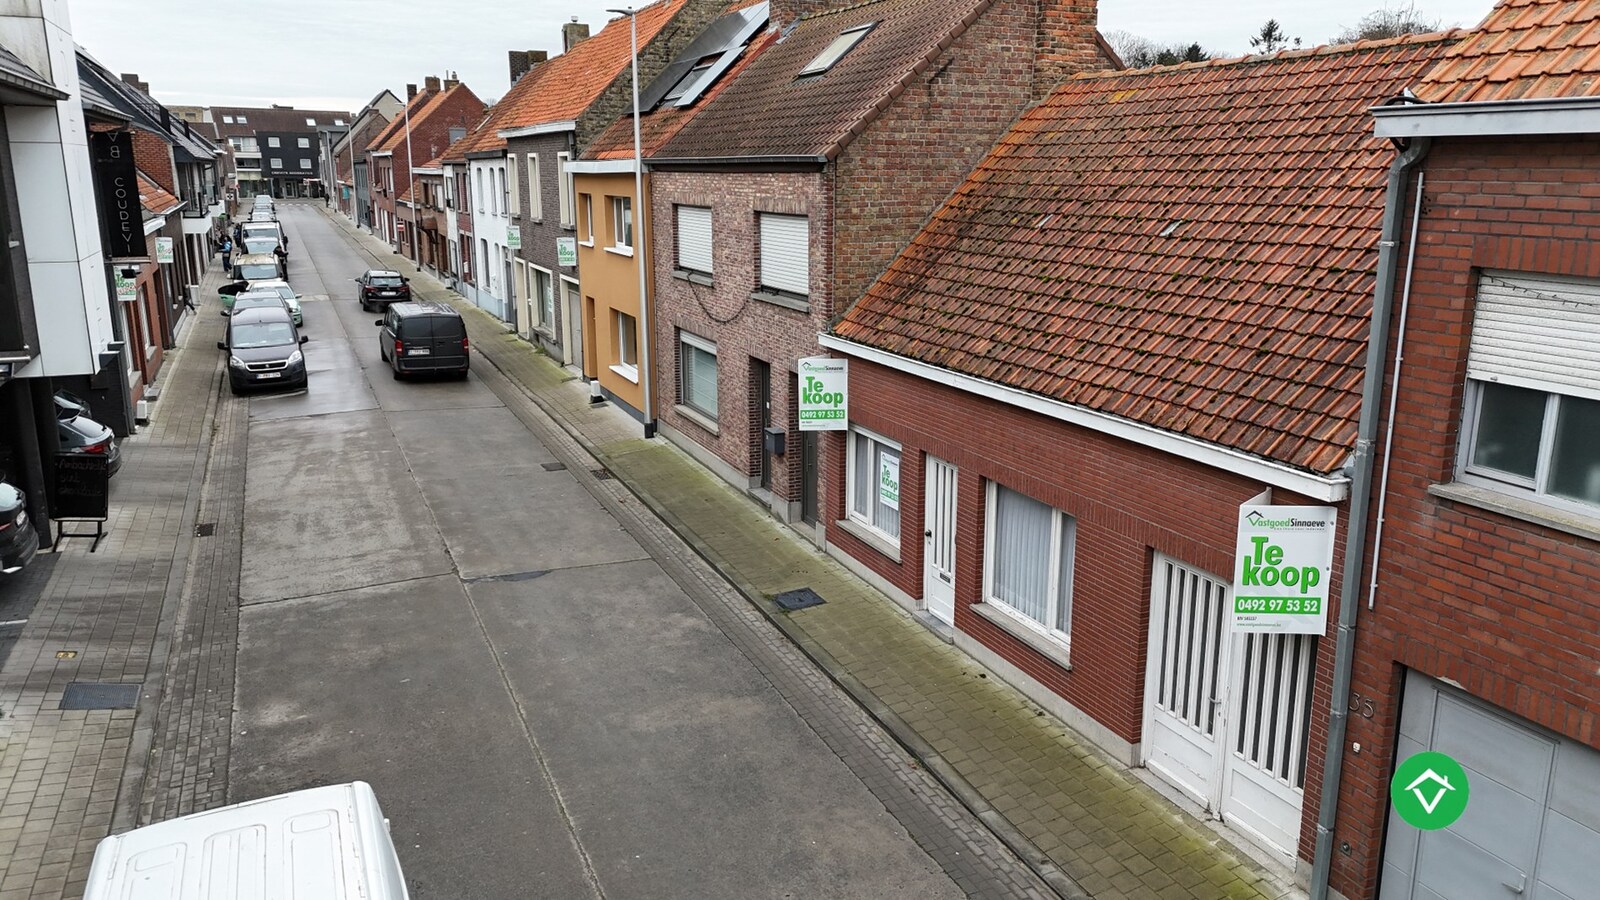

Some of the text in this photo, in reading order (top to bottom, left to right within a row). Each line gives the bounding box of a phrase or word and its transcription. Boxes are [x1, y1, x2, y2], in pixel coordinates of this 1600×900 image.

[805, 376, 824, 392] Te
[802, 387, 844, 408] koop
[883, 464, 891, 478] Te
[881, 471, 898, 493] koop
[1251, 536, 1284, 566] Te
[1242, 556, 1320, 594] koop
[1237, 599, 1318, 612] 0492 97 53 52
[1349, 692, 1374, 718] 35
